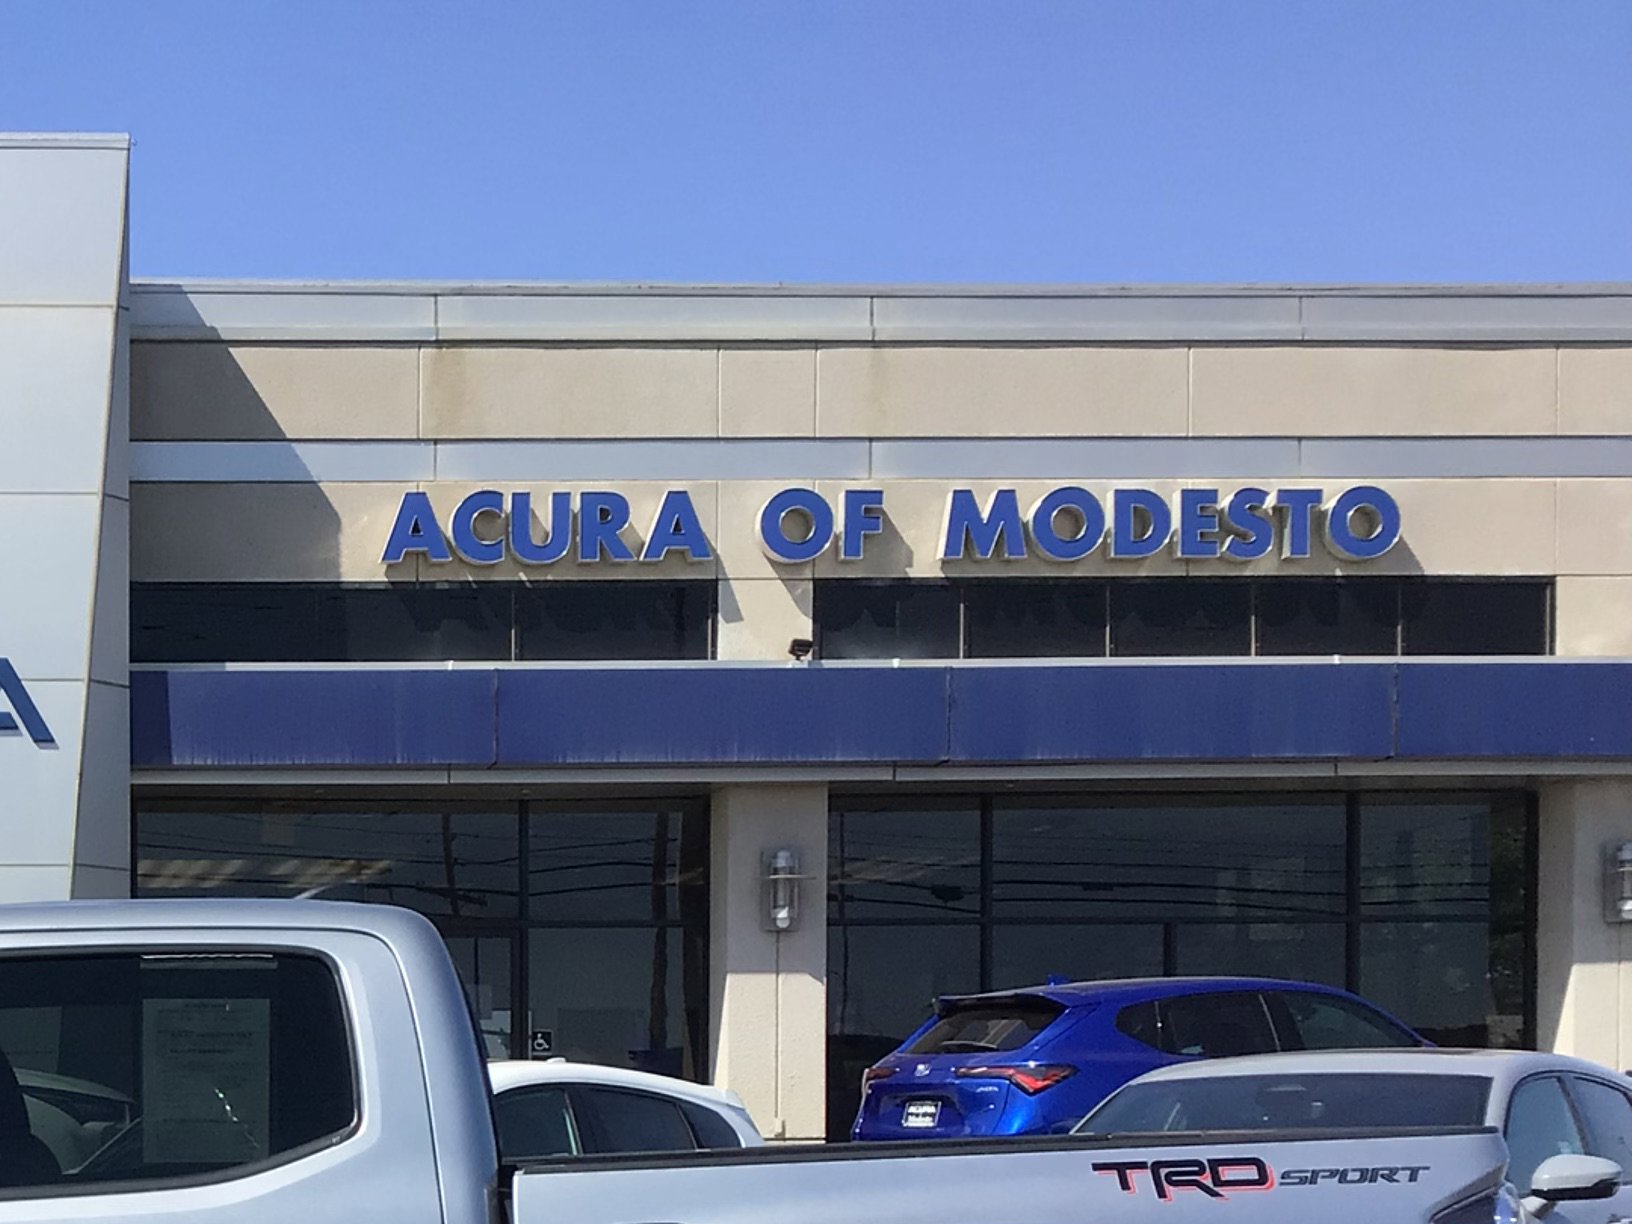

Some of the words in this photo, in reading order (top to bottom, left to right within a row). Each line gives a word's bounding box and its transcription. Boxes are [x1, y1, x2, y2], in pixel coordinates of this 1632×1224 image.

[382, 489, 712, 563] ACURA
[759, 486, 883, 563] OF
[941, 485, 1402, 563] MODESTO
[1091, 1156, 1275, 1202] TRD
[1279, 1166, 1430, 1187] SPORT
